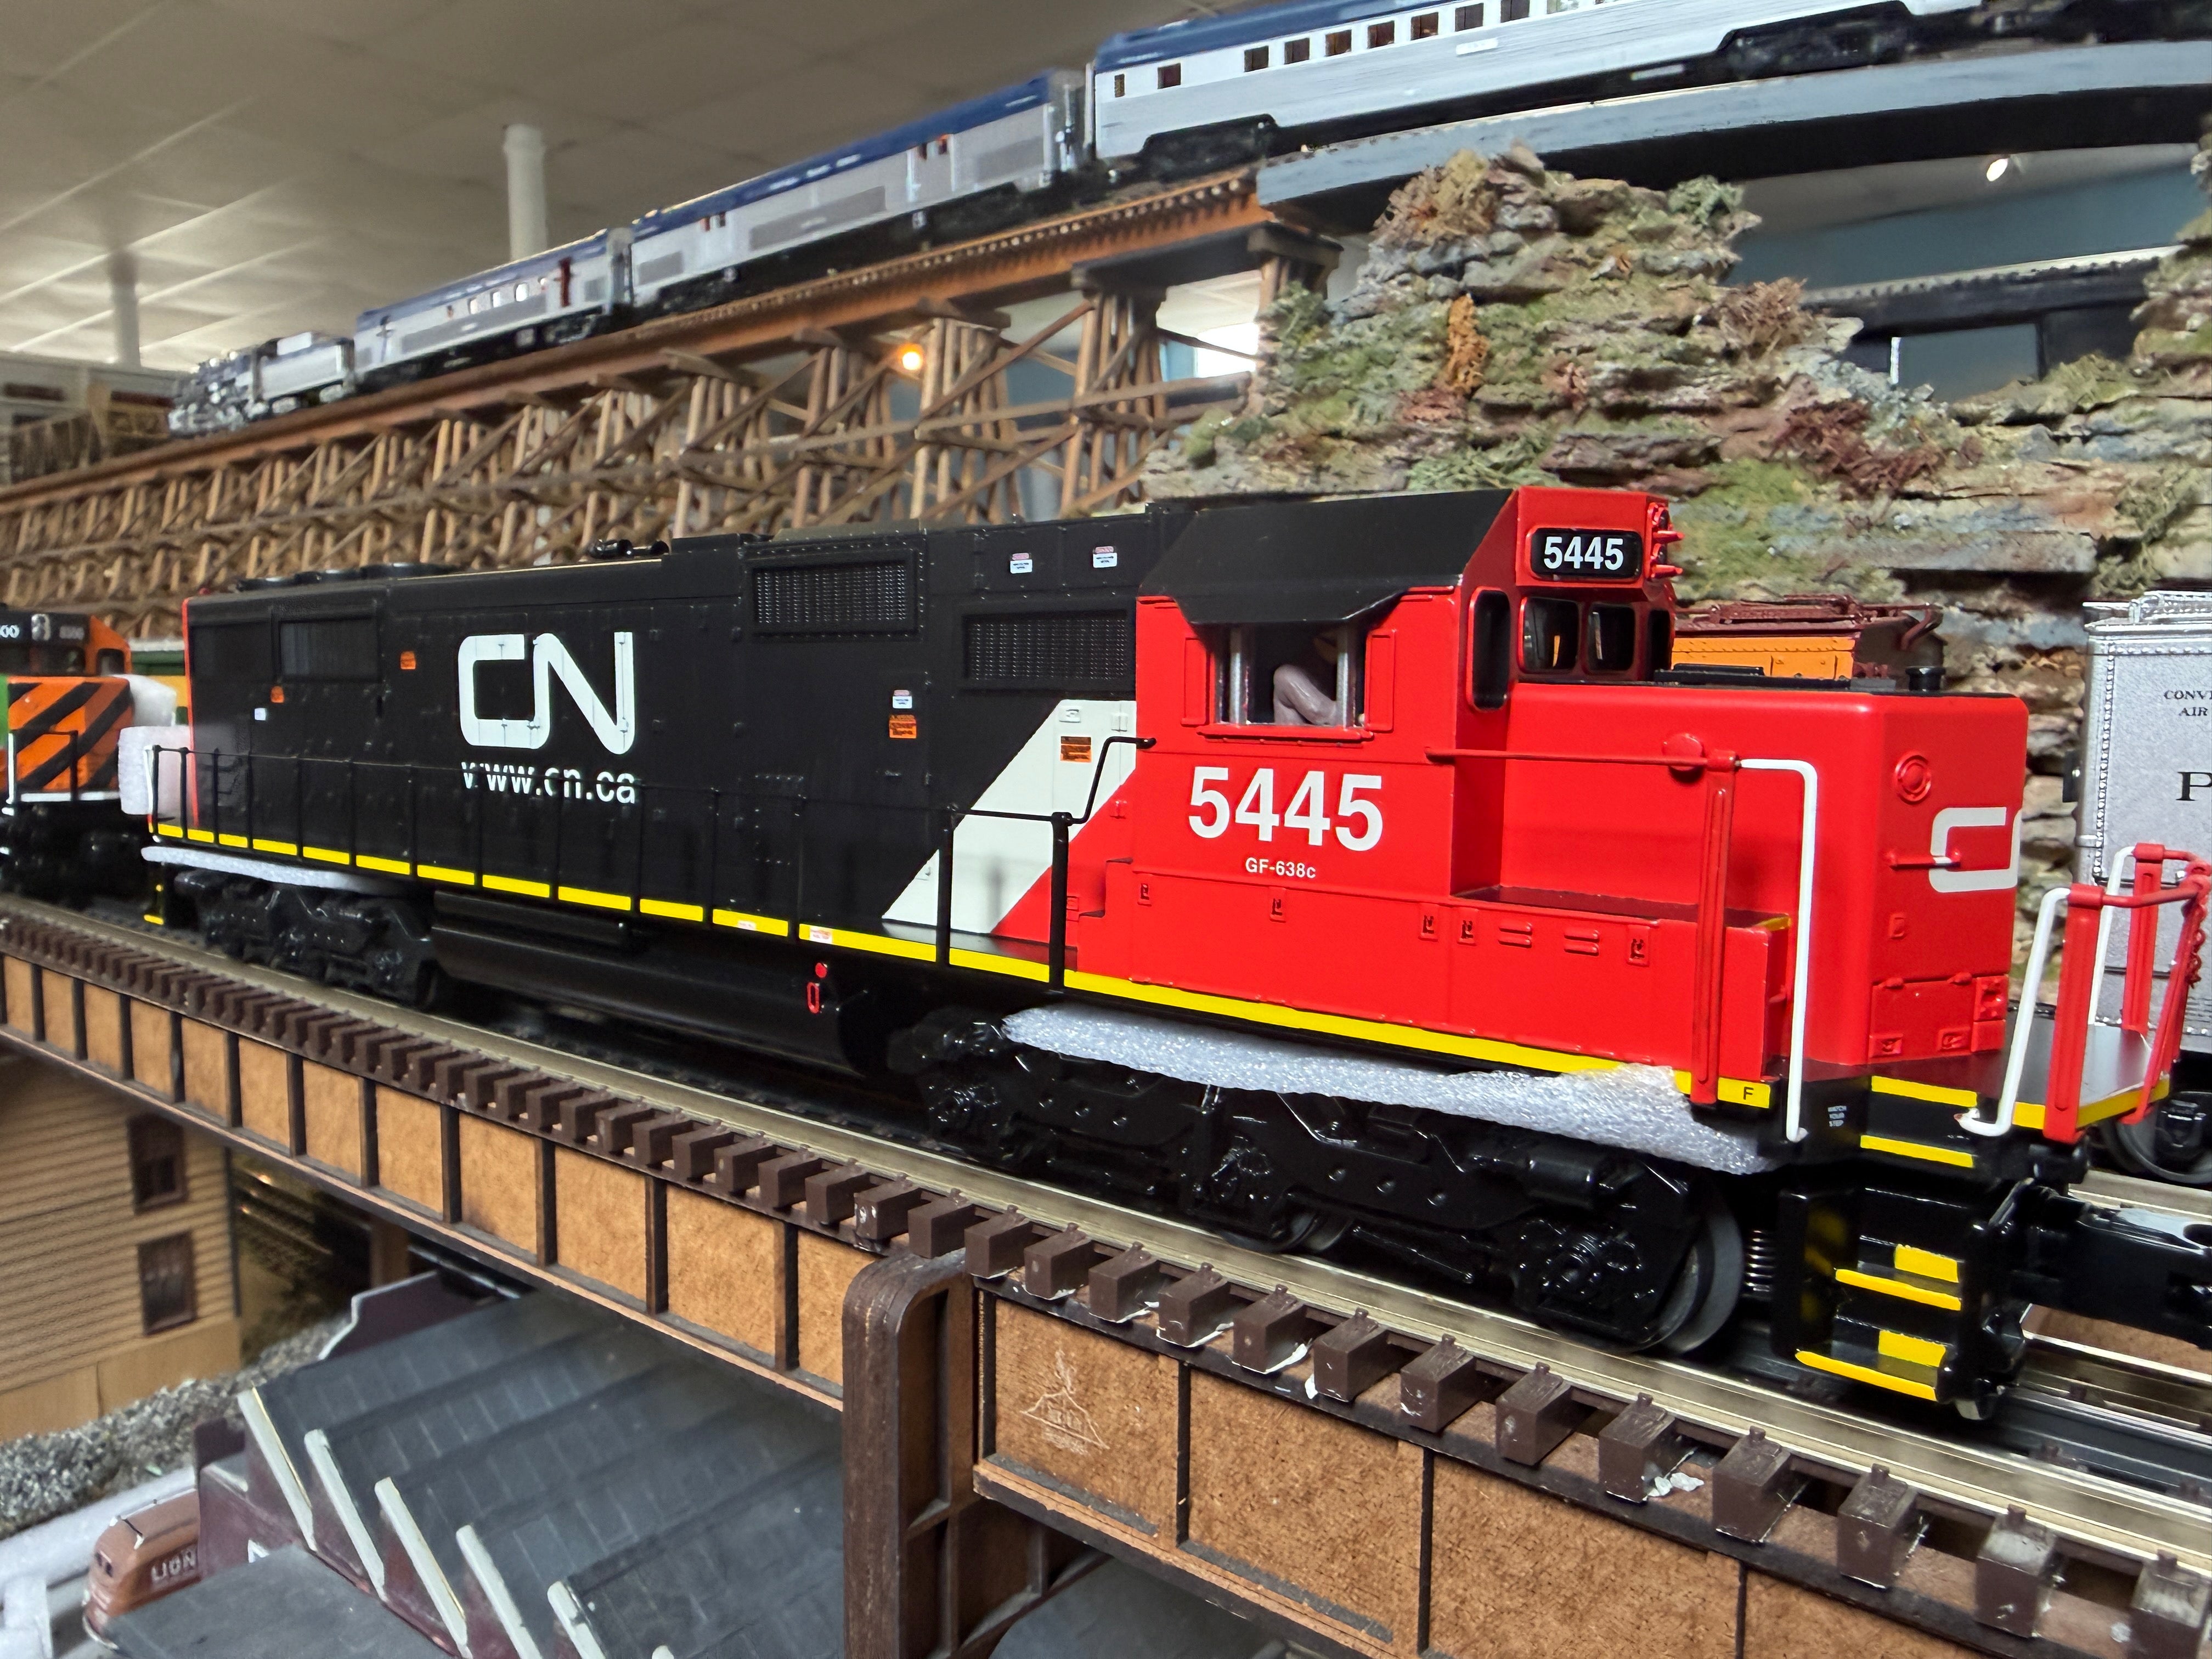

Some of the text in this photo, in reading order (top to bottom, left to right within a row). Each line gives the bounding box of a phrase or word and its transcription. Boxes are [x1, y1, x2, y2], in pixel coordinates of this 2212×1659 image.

[1544, 536, 1624, 571] 5445
[458, 631, 636, 755] CN
[2163, 690, 2212, 699] CONV
[2179, 707, 2208, 716] AIR
[1188, 766, 1384, 852] 5445
[1245, 857, 1317, 879] GF-638c
[1743, 1086, 1754, 1100] F
